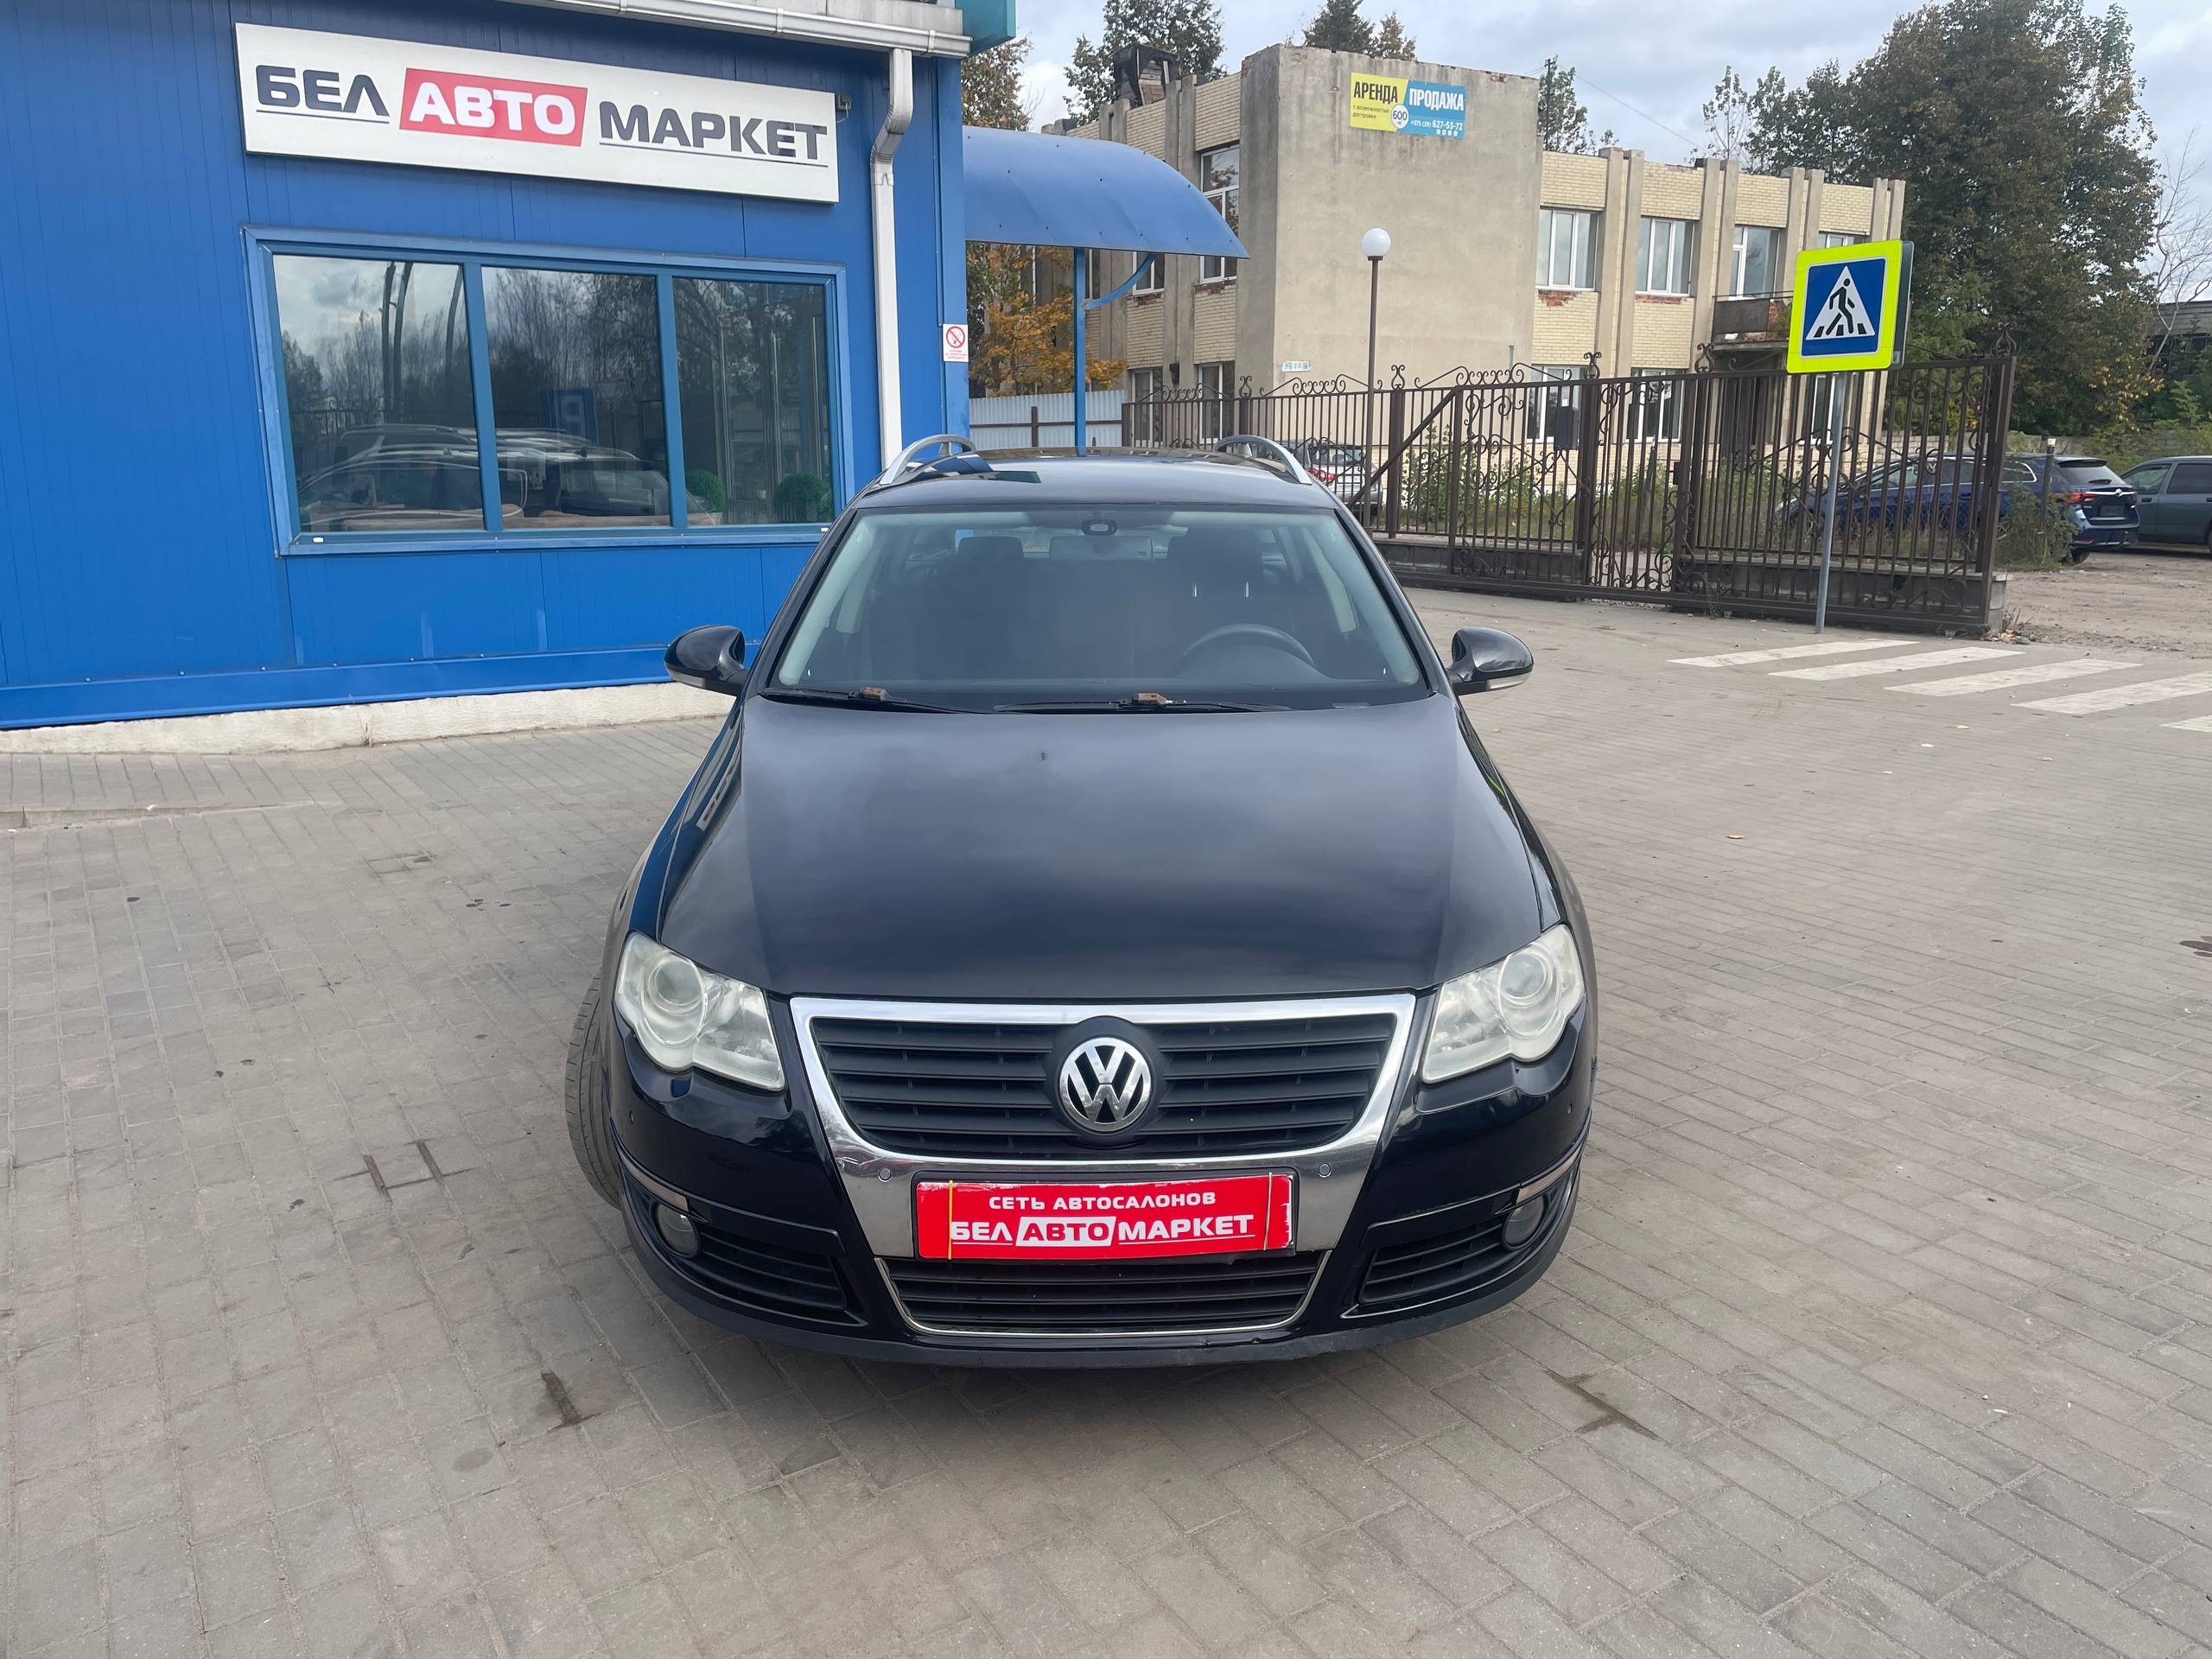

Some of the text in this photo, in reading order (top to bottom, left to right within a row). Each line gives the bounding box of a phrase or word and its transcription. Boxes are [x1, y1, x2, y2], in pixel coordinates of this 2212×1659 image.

[1353, 81, 1398, 104] АРЕНДА
[1409, 88, 1464, 111] ПРОДАЖА
[256, 65, 827, 161] БЕЛ АВТО МАРКЕТ
[1392, 110, 1408, 121] 600
[1433, 120, 1463, 130] 627-53-72
[989, 1192, 1216, 1211] СЕТЬ АВТОСАЛОНОВ
[951, 1214, 1254, 1242] БЕЛ АВТО МАРКЕТ
